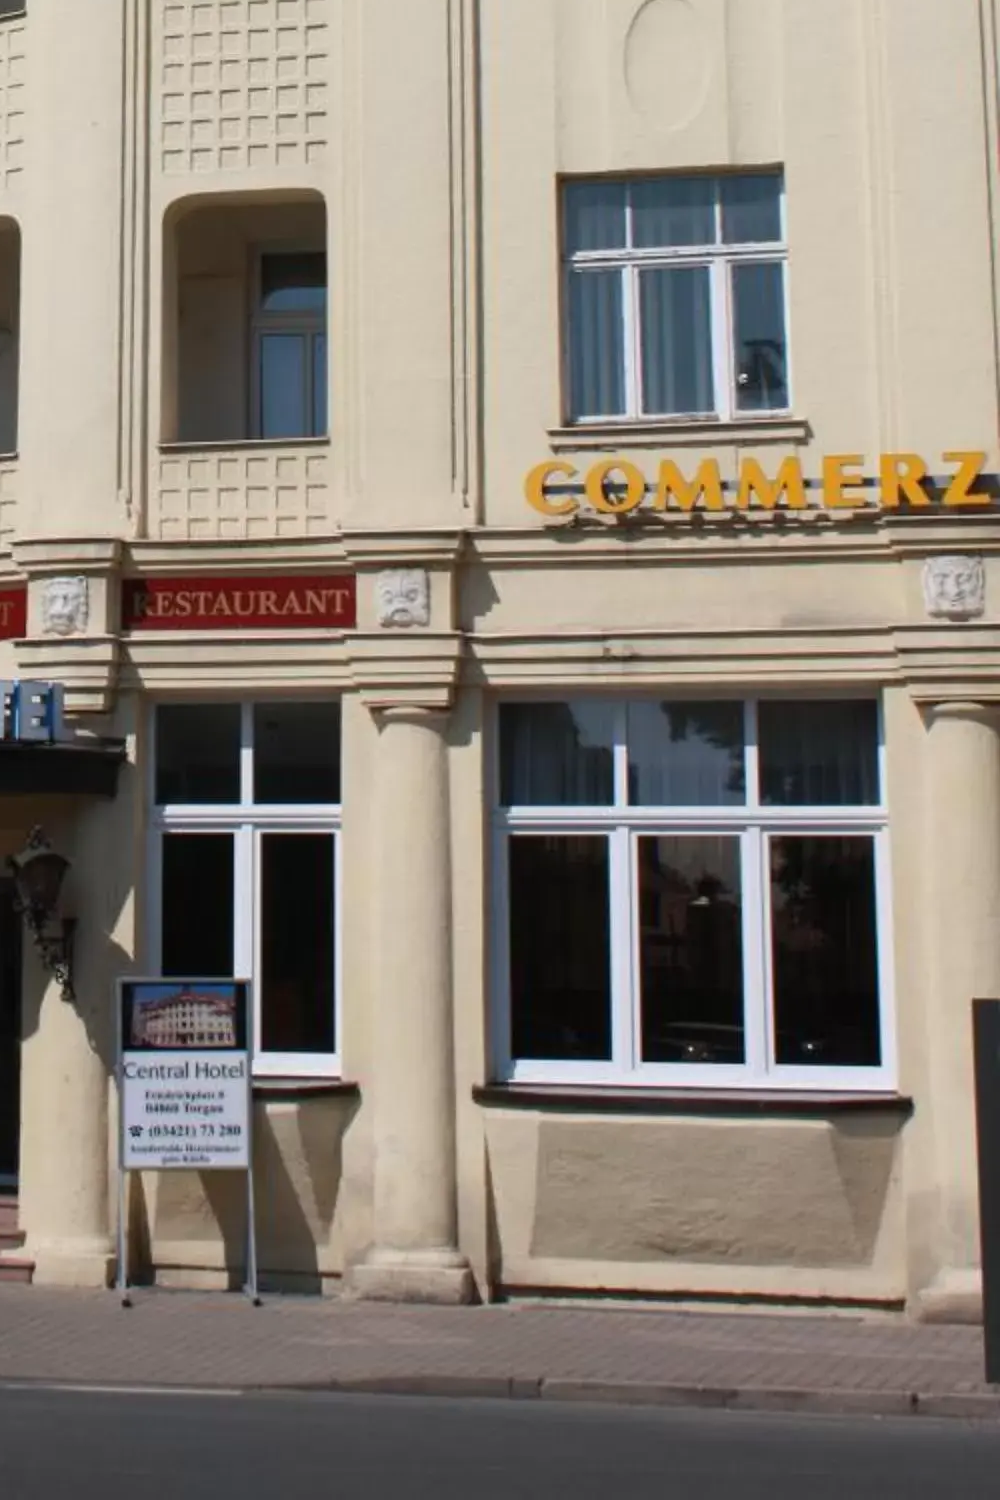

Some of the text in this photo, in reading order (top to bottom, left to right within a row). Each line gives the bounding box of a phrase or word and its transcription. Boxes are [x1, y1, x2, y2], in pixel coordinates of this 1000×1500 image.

[524, 451, 991, 515] COMMERZ
[133, 588, 350, 617] RESTAURANT
[124, 1061, 245, 1079] Central Hotel
